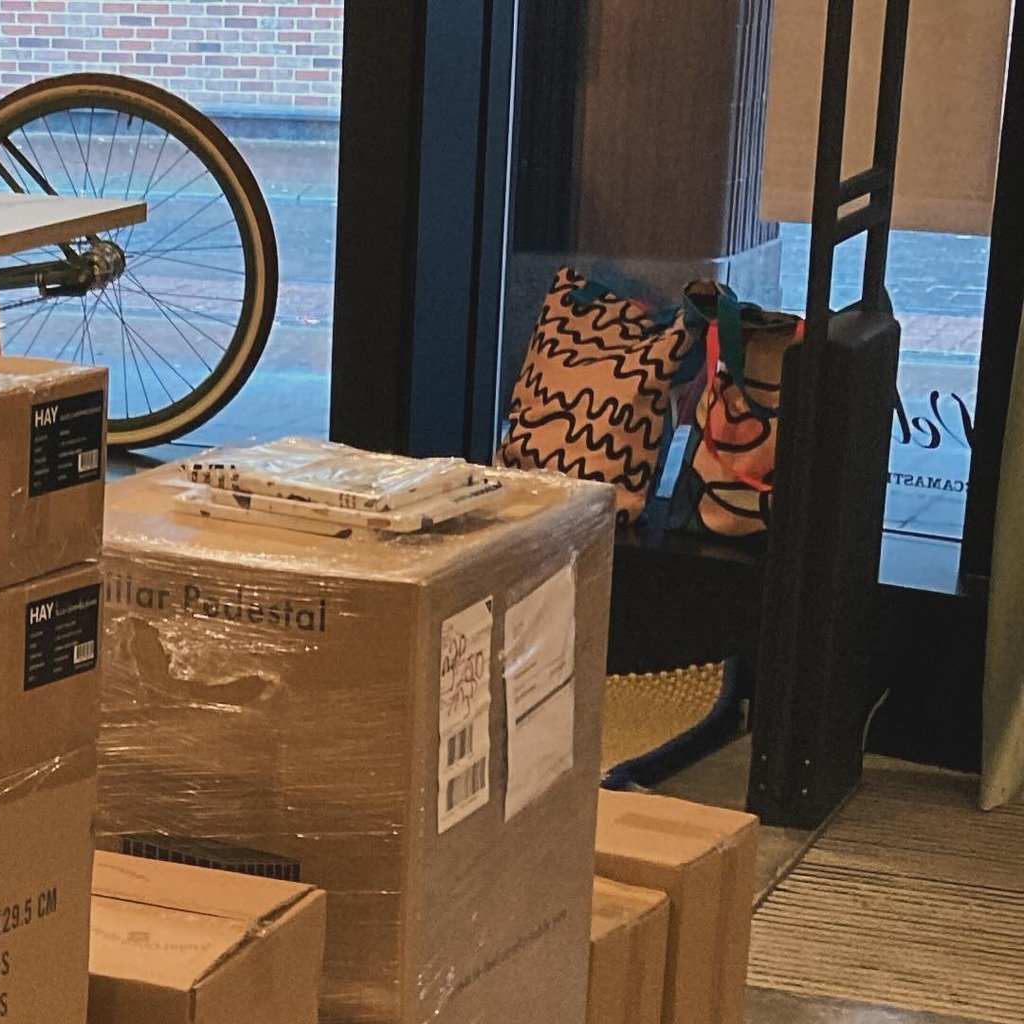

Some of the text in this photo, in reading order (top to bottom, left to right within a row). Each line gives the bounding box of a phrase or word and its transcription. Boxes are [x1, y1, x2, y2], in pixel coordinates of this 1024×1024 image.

[34, 405, 58, 428] HAY
[30, 602, 53, 625] HAY
[184, 584, 326, 633] Pedestal
[38, 887, 57, 919] CM
